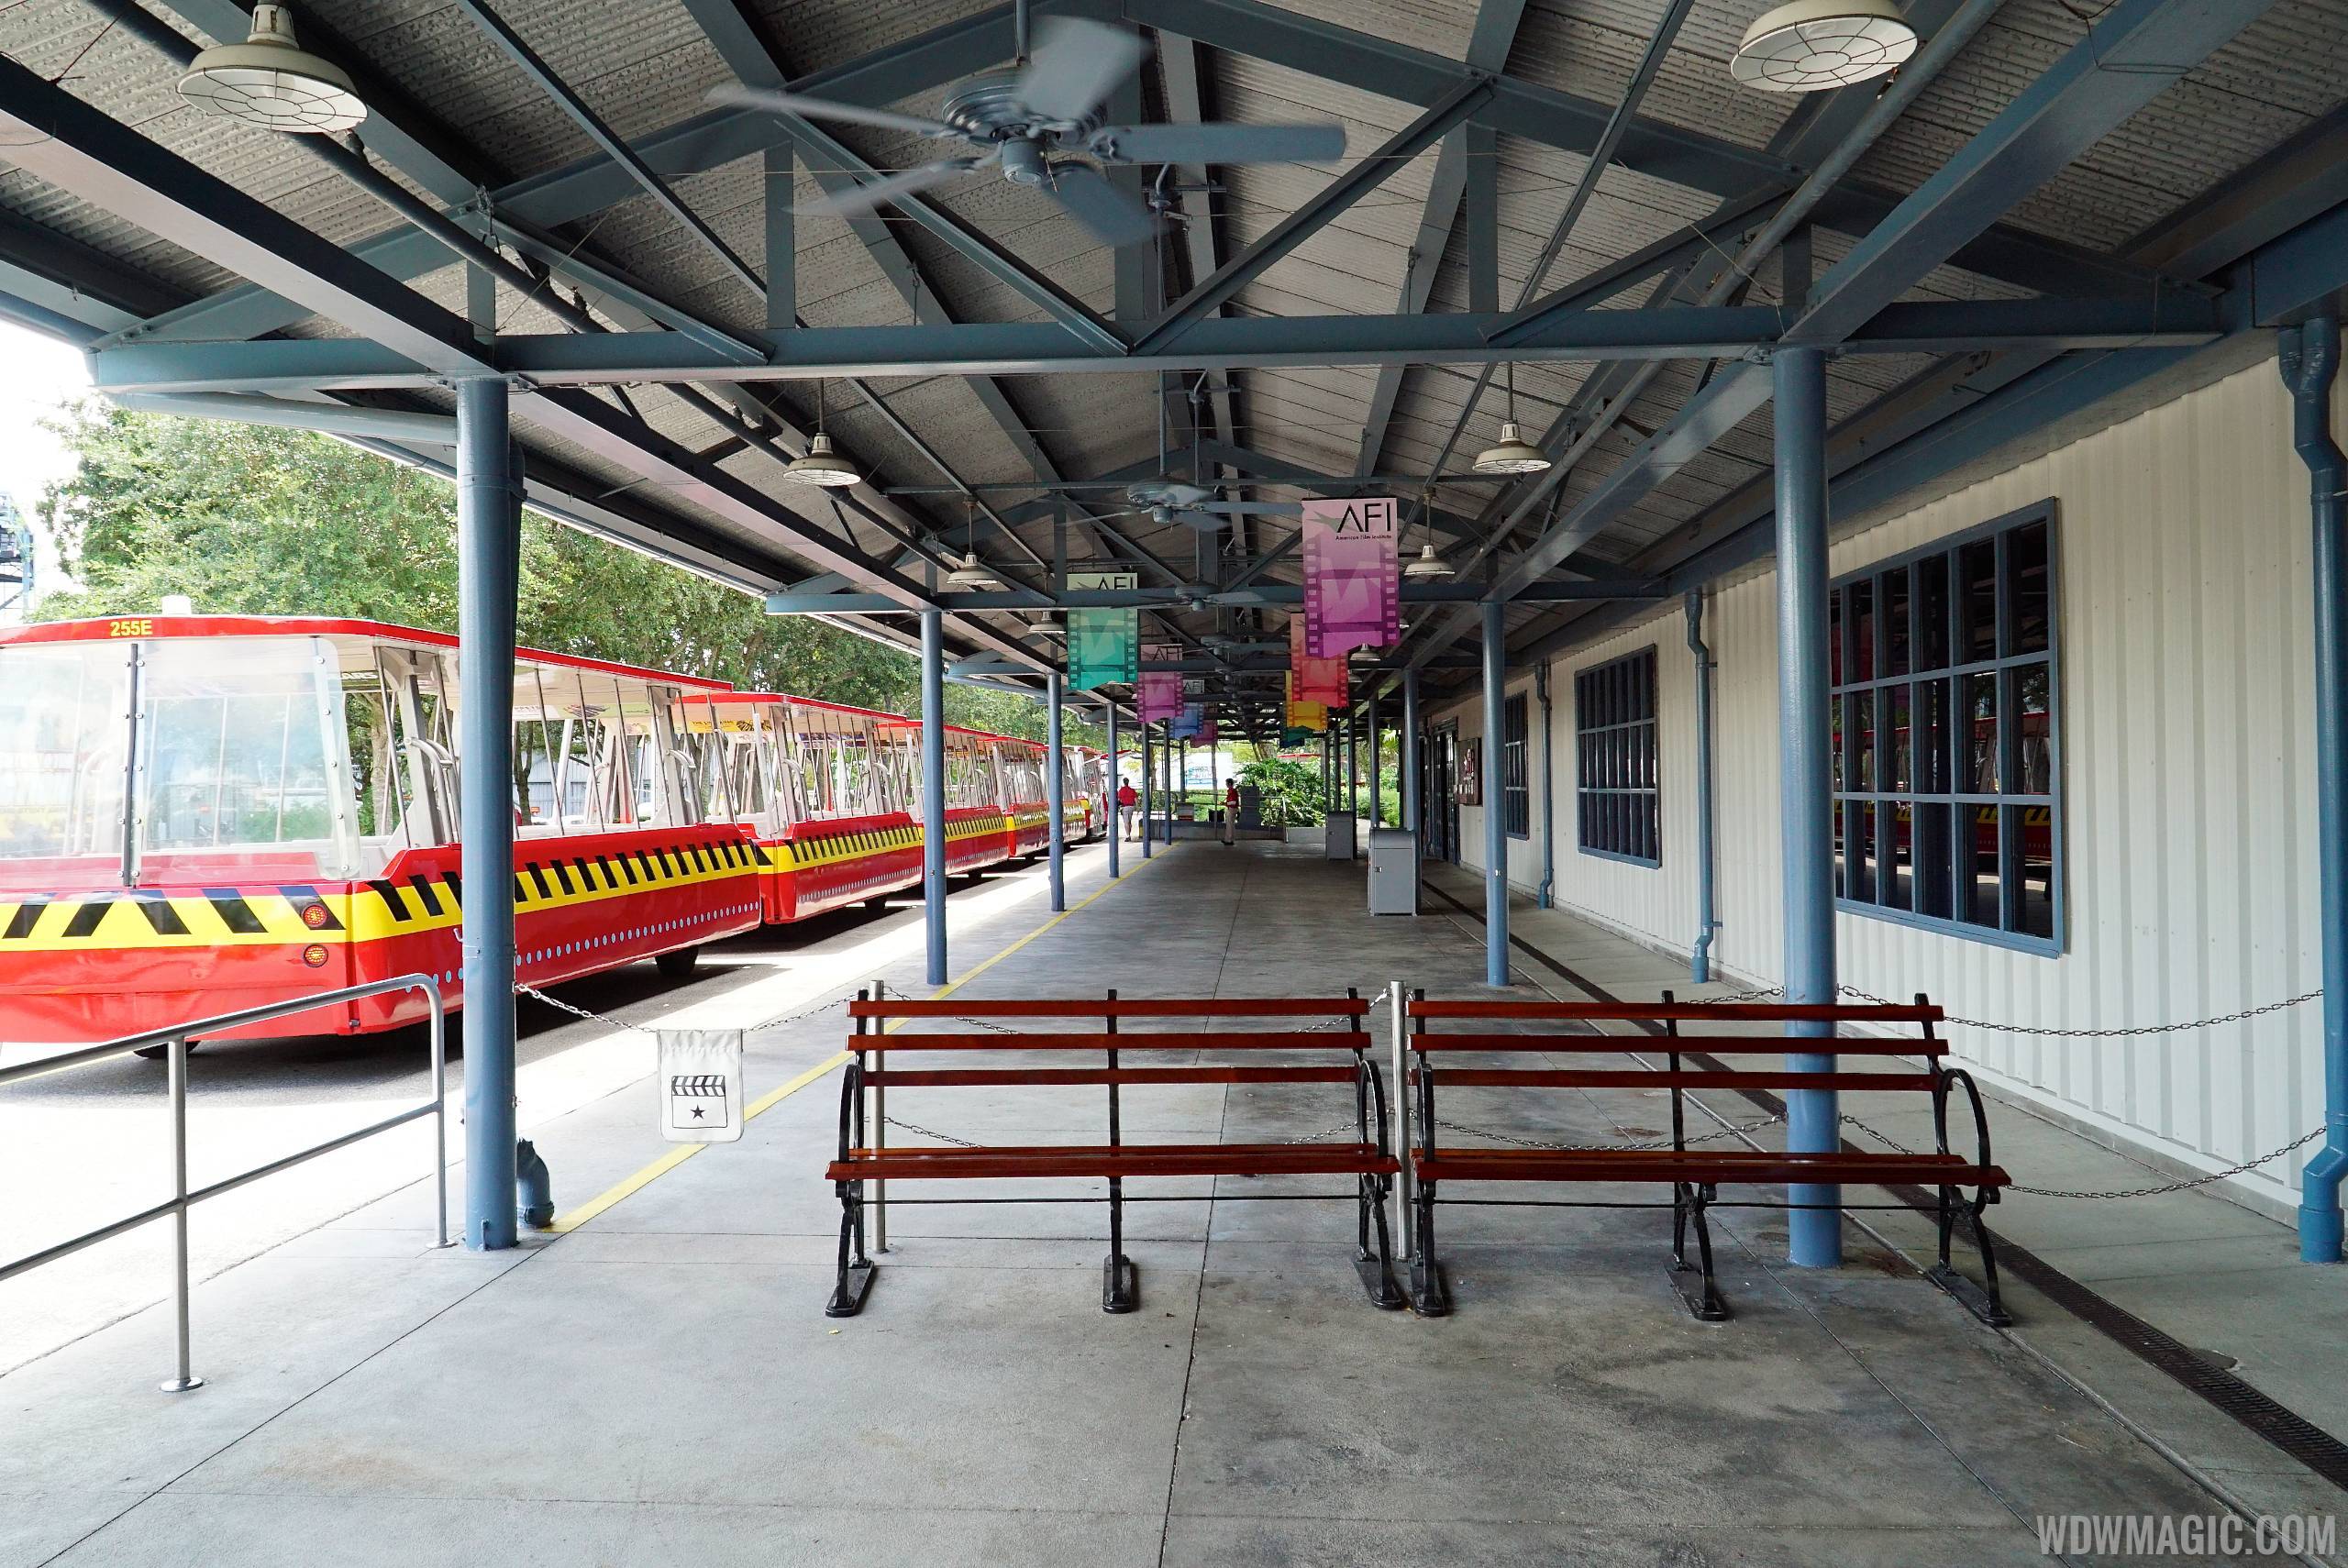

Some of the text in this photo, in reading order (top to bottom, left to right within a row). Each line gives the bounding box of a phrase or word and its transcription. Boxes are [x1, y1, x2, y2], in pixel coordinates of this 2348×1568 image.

[1336, 502, 1391, 533] AFI
[1098, 576, 1134, 590] AFI
[110, 619, 153, 637] 255E
